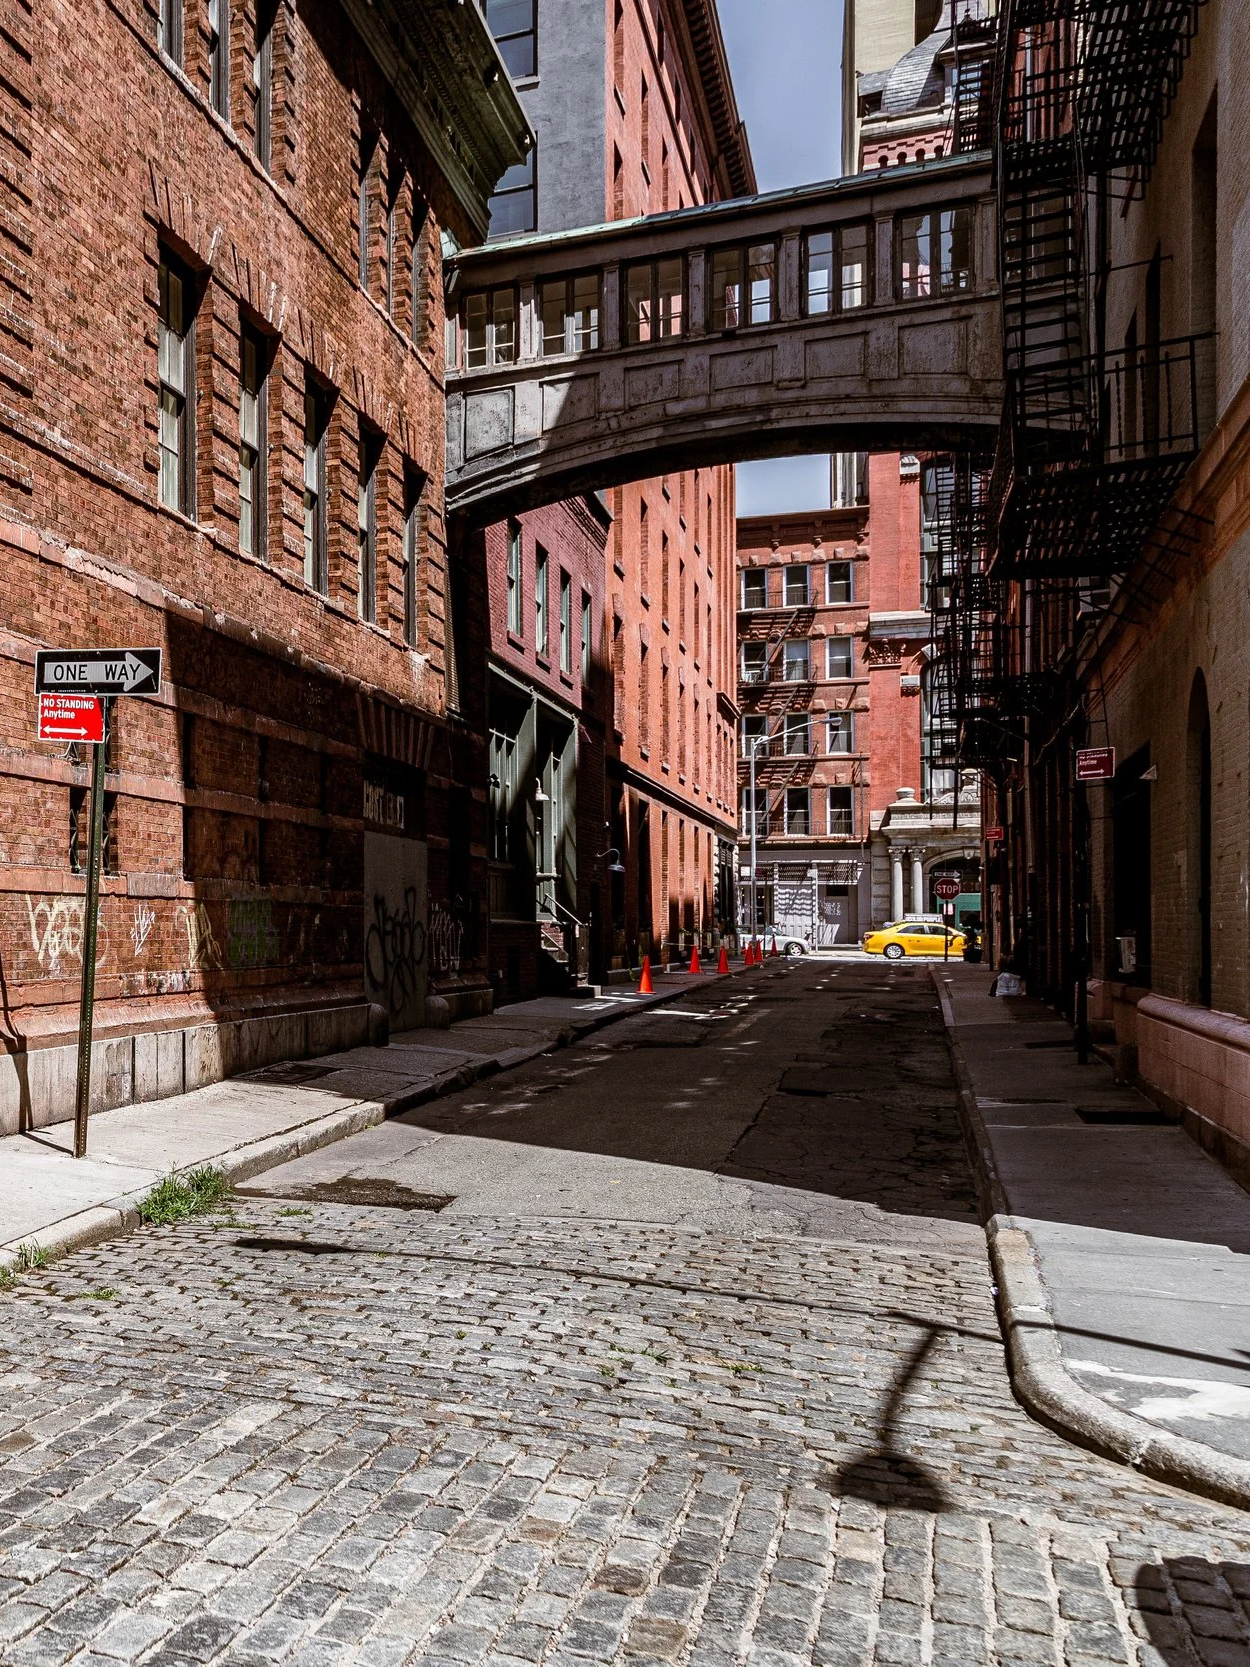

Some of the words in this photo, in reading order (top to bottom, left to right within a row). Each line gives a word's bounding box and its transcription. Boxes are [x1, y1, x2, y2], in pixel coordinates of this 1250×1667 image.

[53, 664, 88, 681] ONE
[104, 663, 142, 681] WAY
[43, 698, 54, 708] NO
[56, 699, 95, 710] STANDING
[43, 709, 76, 720] Anytime
[937, 885, 958, 894] STOP
